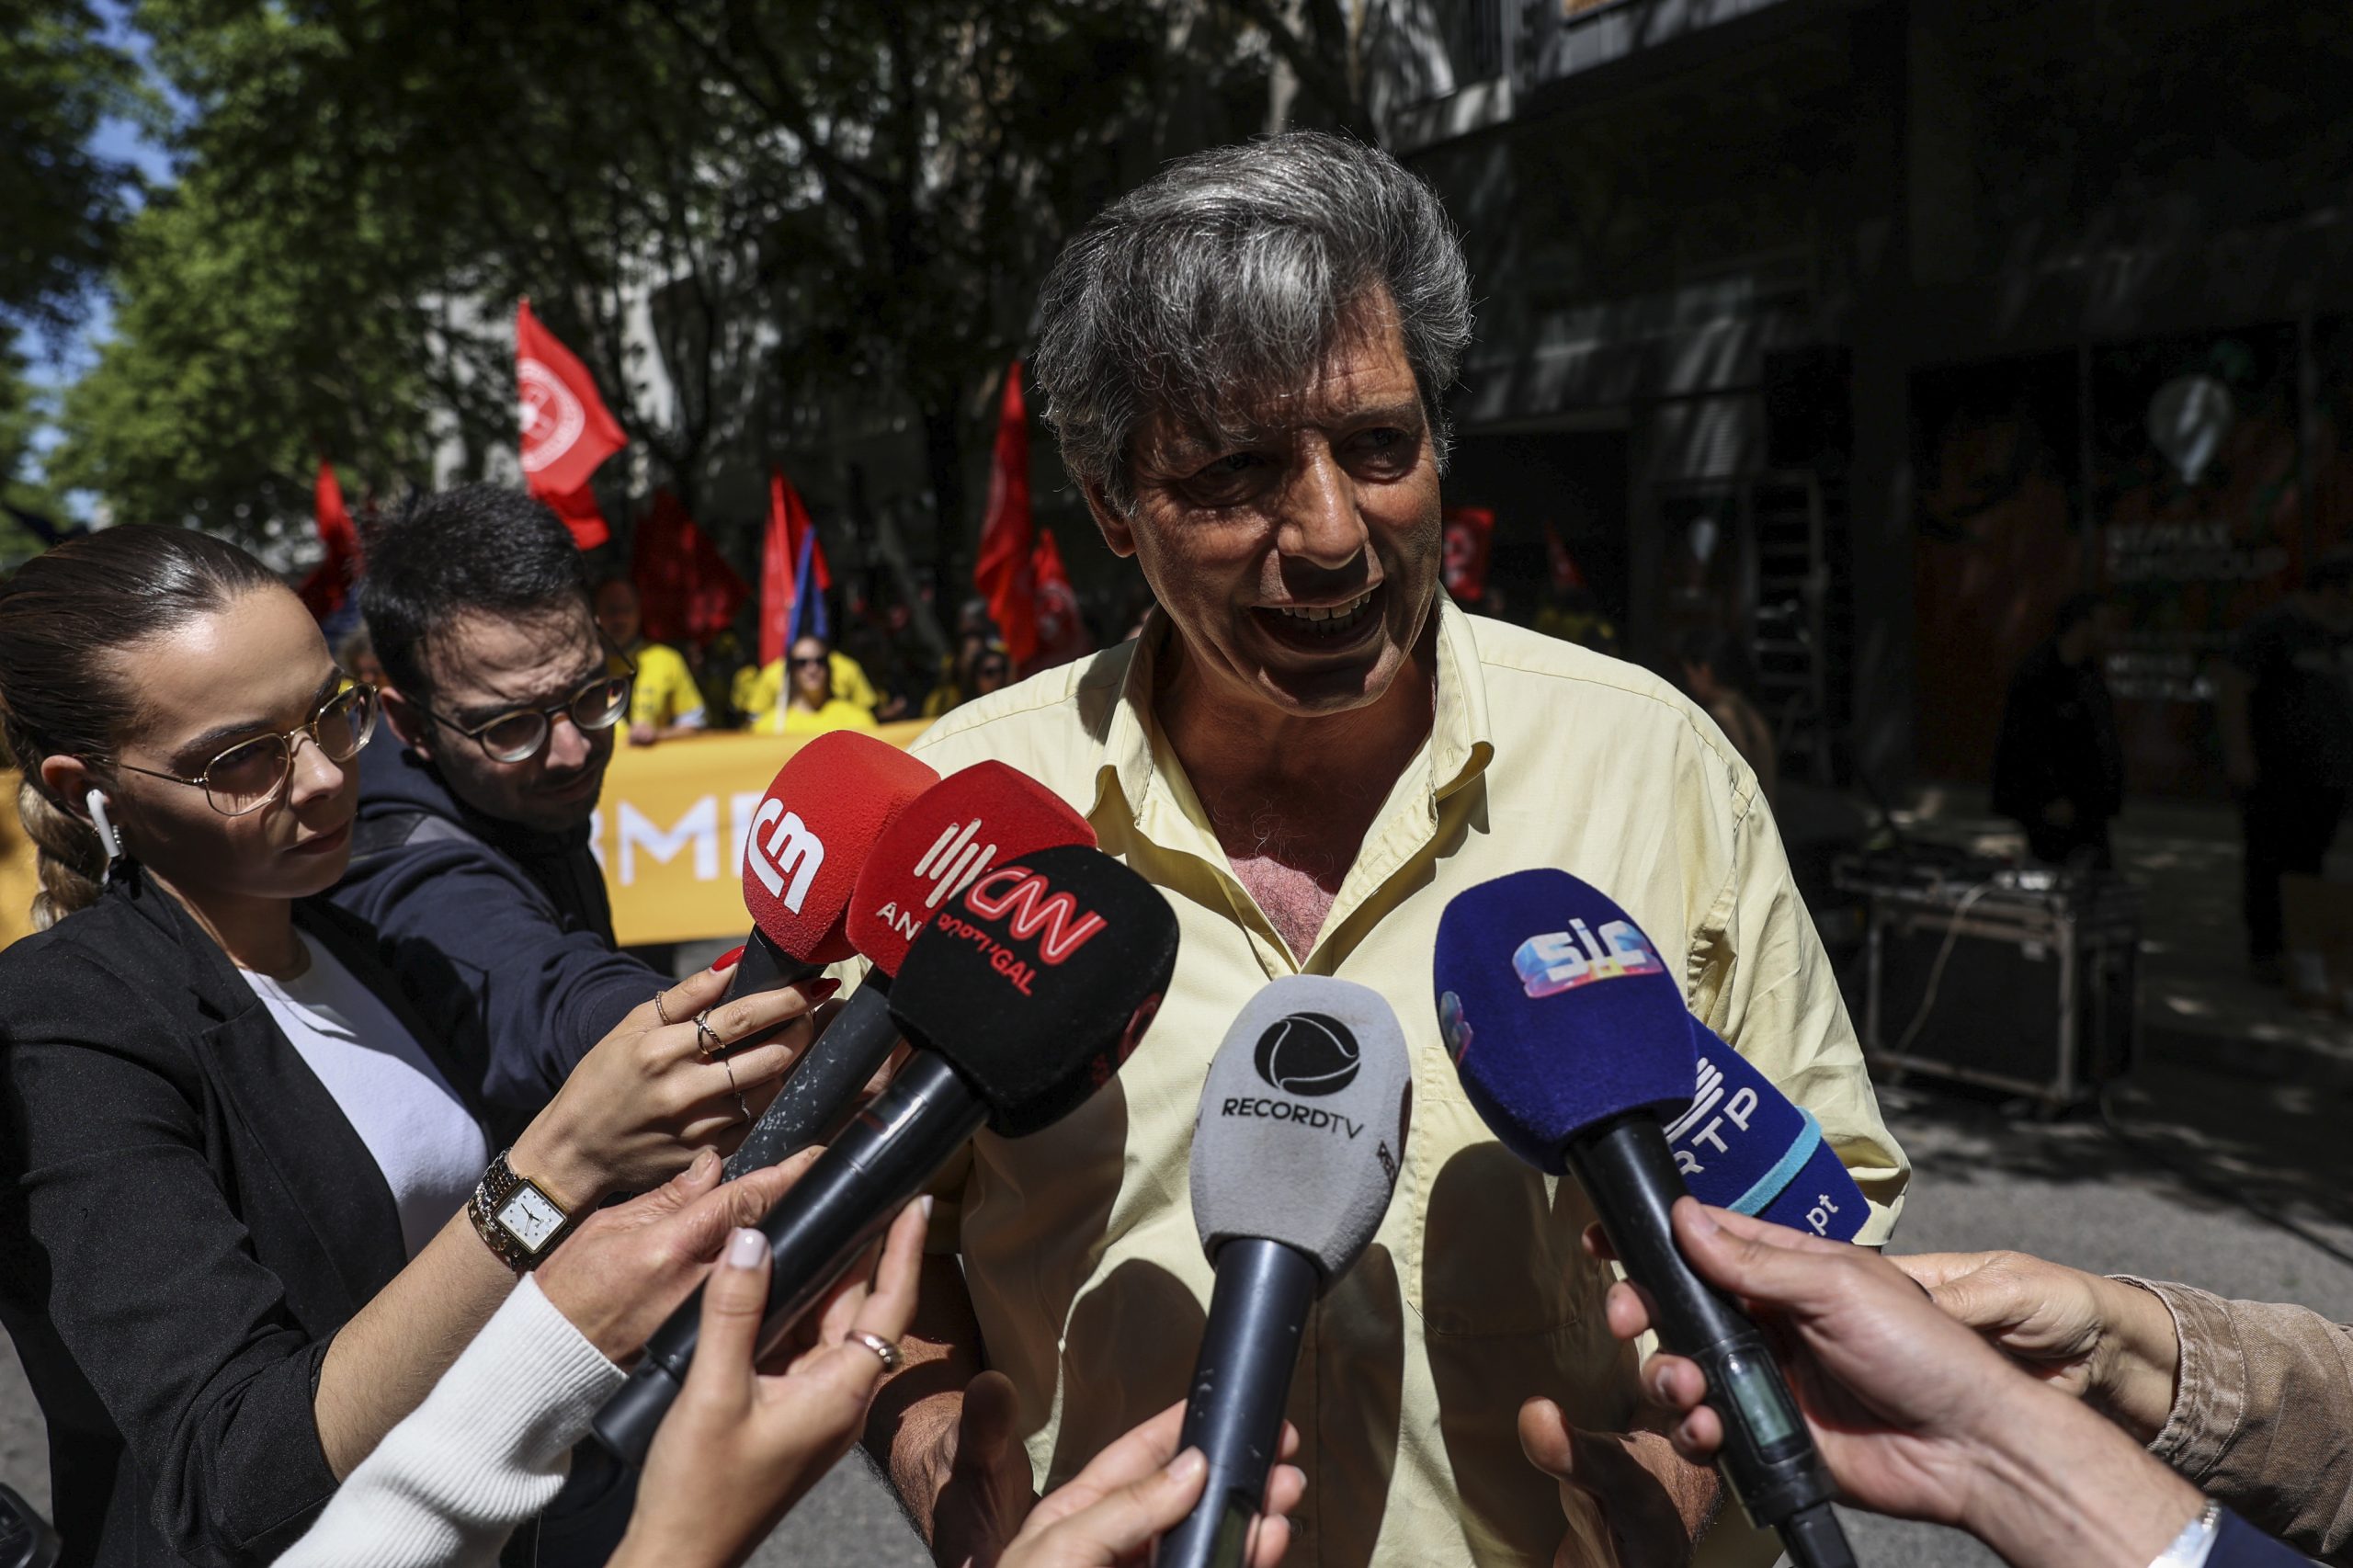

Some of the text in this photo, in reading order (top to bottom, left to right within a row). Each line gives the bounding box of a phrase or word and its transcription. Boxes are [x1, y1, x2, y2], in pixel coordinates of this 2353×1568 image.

[938, 913, 1037, 997] PORTGAL
[964, 865, 1108, 965] CNN
[1673, 1087, 1757, 1176] RTP
